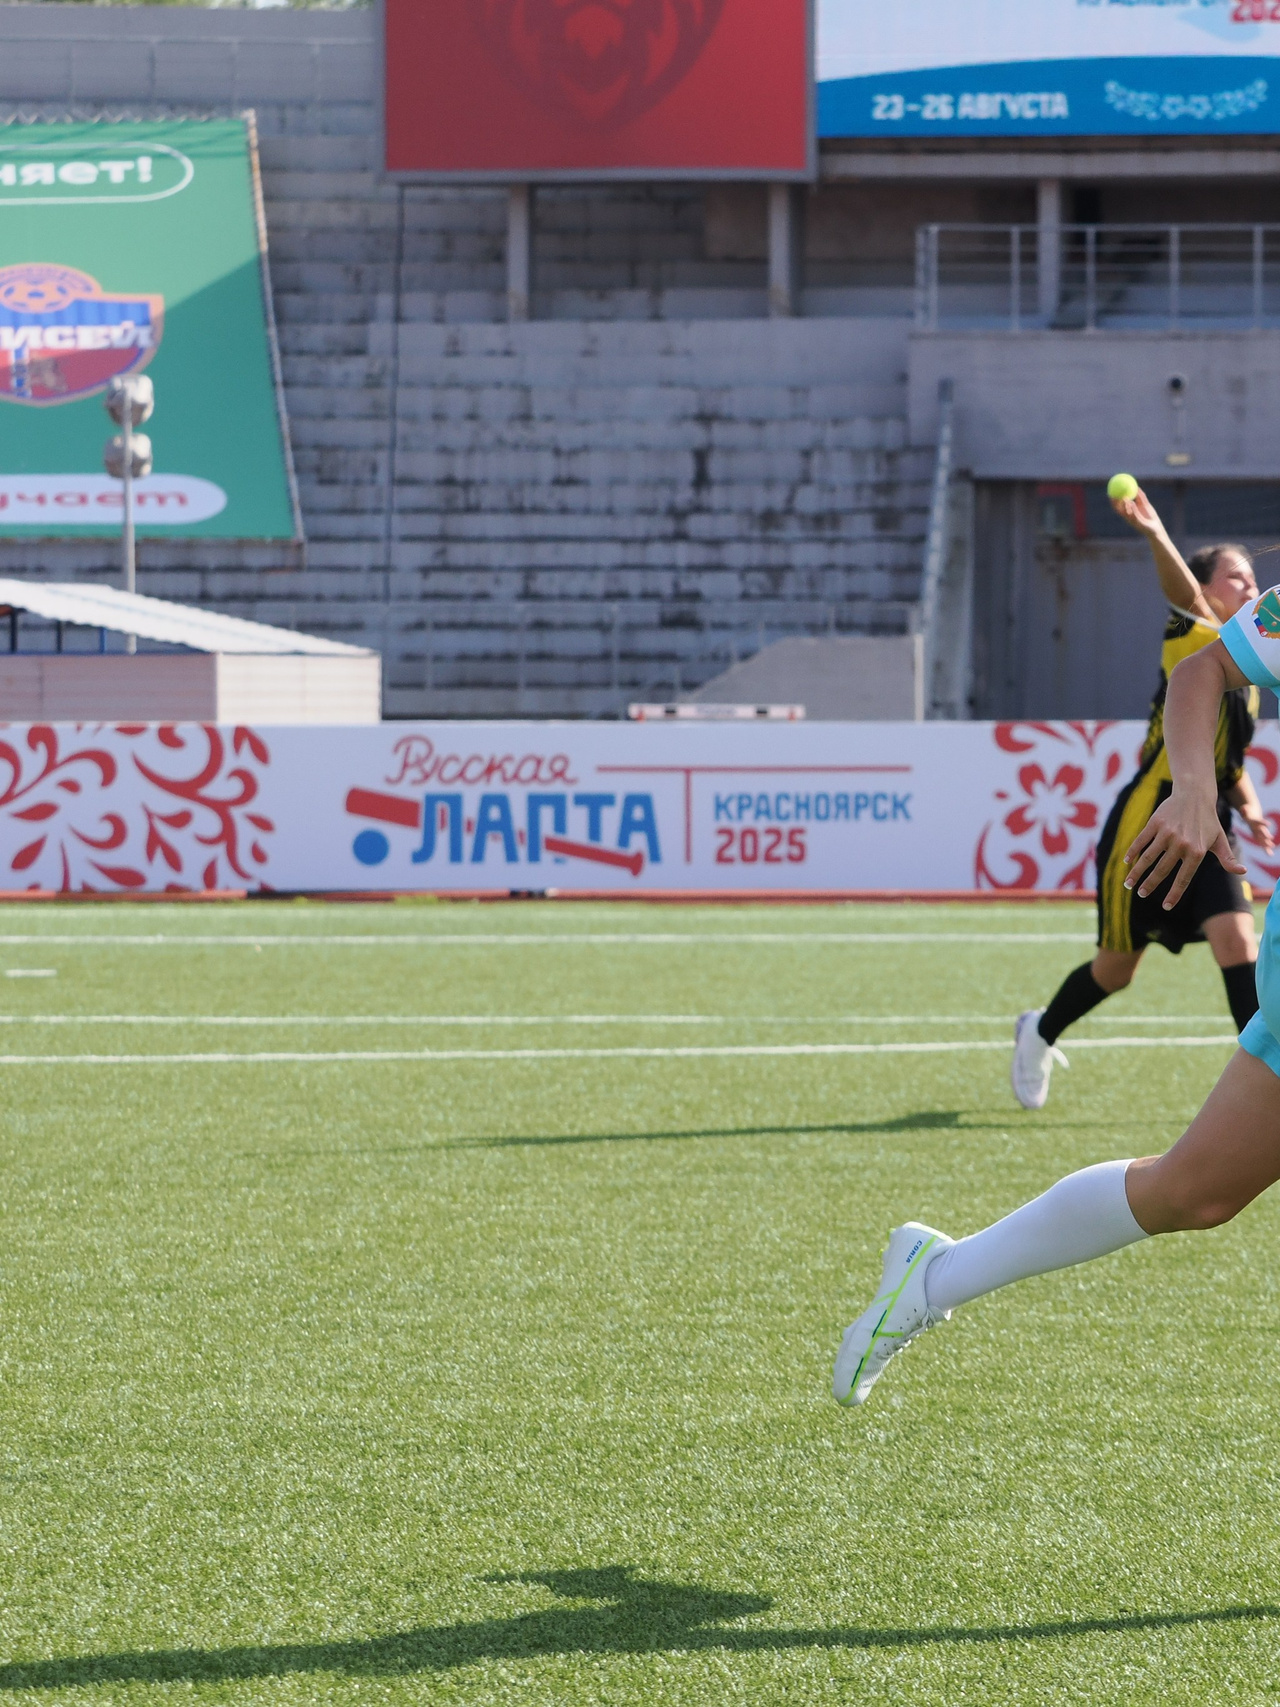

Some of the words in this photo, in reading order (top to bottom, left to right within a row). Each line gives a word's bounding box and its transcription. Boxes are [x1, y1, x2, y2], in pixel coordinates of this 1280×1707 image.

[957, 92, 1069, 120] АВГУСТА
[385, 735, 578, 785] Русская
[714, 792, 913, 822] КРАСНОЯРСК
[411, 793, 662, 865] ЛАПТА
[714, 828, 807, 864] 2025
